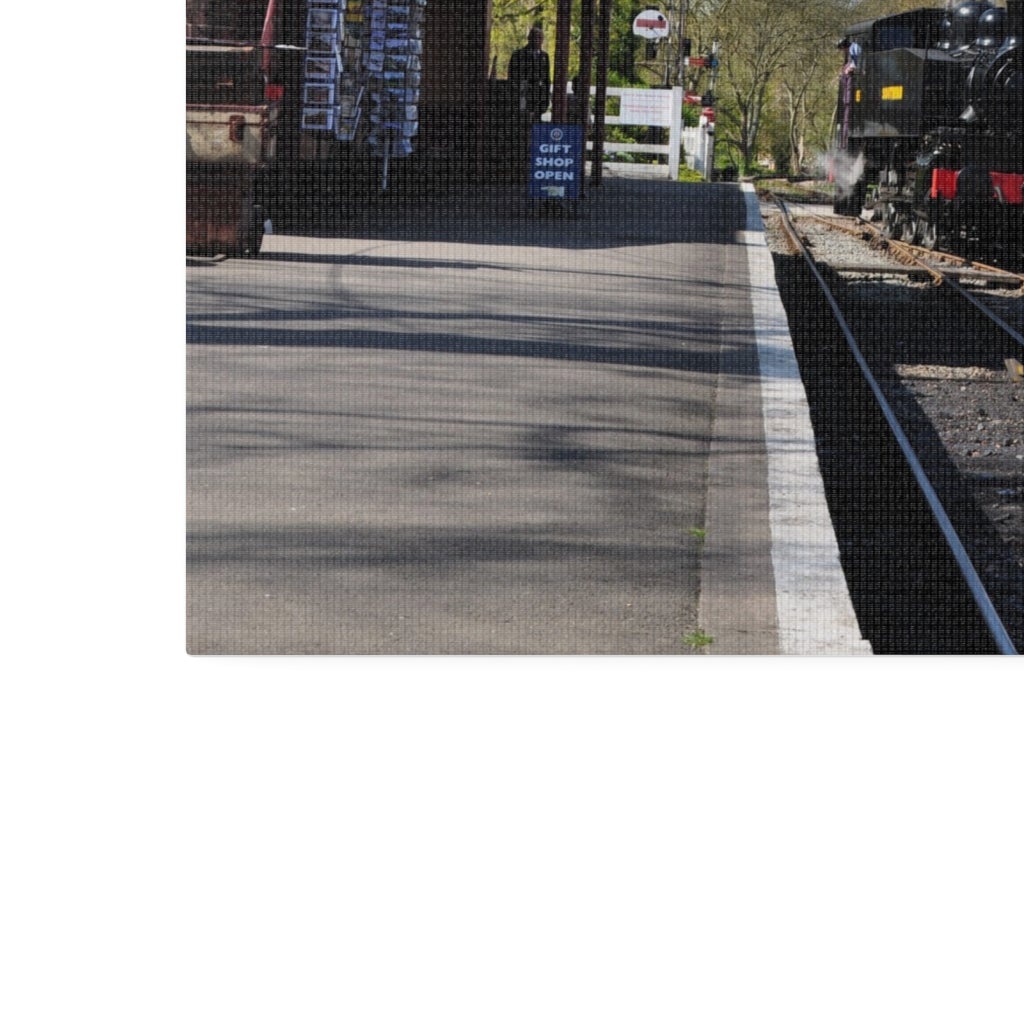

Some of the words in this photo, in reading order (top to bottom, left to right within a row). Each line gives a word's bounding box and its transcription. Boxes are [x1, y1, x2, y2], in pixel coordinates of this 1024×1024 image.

[539, 143, 573, 154] GIFT
[535, 157, 574, 167] SHOP
[534, 170, 575, 181] OPEN
